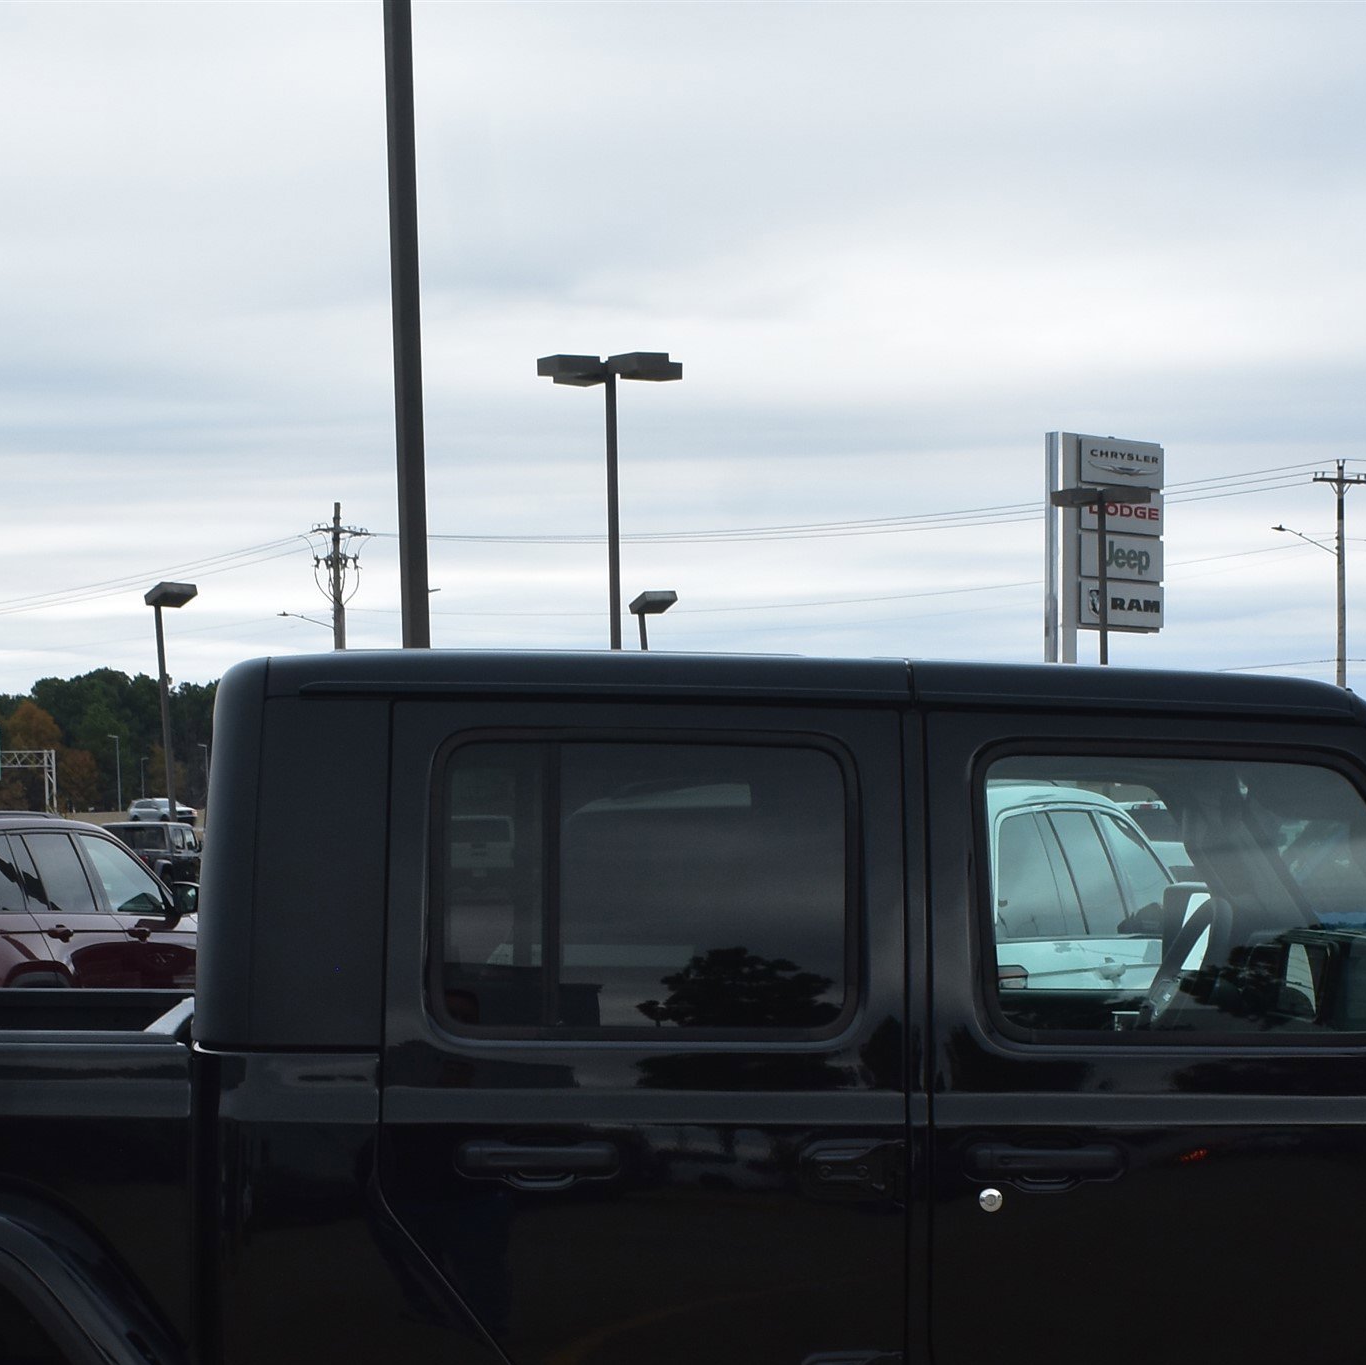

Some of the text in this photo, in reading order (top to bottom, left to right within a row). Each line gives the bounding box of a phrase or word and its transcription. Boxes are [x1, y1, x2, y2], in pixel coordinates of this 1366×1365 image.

[1090, 449, 1159, 464] CHRYSLER
[1106, 540, 1150, 575] Jeep
[1111, 597, 1160, 613] RAM
